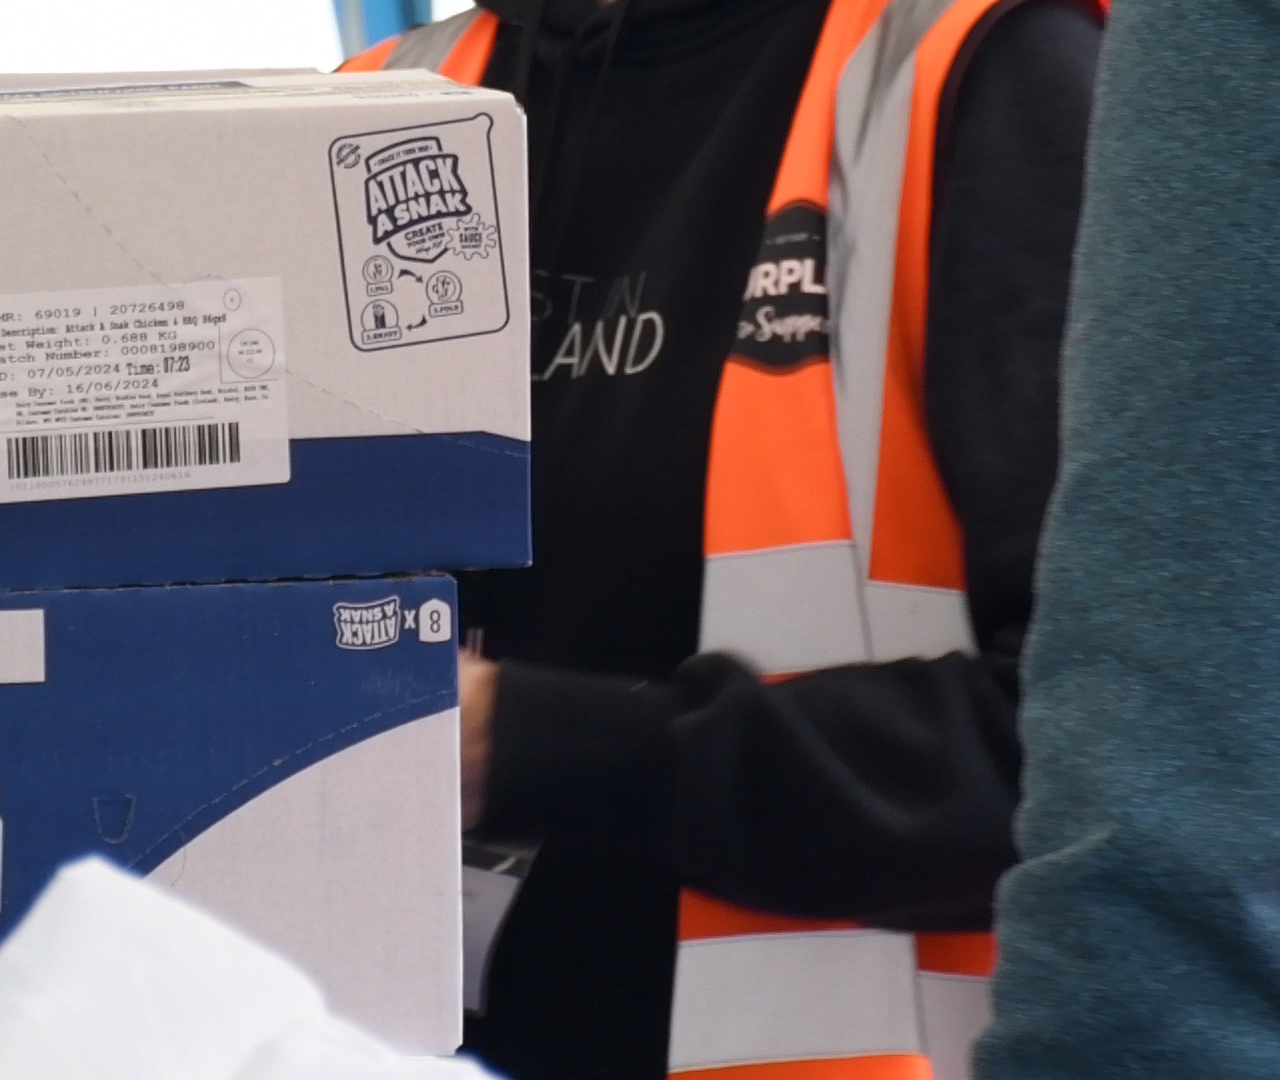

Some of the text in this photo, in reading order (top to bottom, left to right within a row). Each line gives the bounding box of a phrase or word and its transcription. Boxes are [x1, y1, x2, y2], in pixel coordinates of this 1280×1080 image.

[370, 157, 461, 217] ATTACK
[376, 192, 467, 239] A SNAK
[404, 222, 444, 241] CREATE
[459, 233, 483, 243] SAUCE
[34, 308, 81, 320] 69019
[110, 300, 185, 315] 20726498
[25, 338, 89, 351] Weight:
[101, 332, 148, 345] 0.688
[157, 331, 177, 341] KG
[45, 349, 108, 361] Number:
[121, 340, 215, 356] 0008198900
[27, 363, 120, 379] 07/05/2024
[27, 386, 54, 399] By:
[66, 378, 159, 394] 16/06/2024
[339, 601, 396, 622] A SNAK
[429, 610, 441, 633] 8
[340, 617, 396, 645] ATTACK
